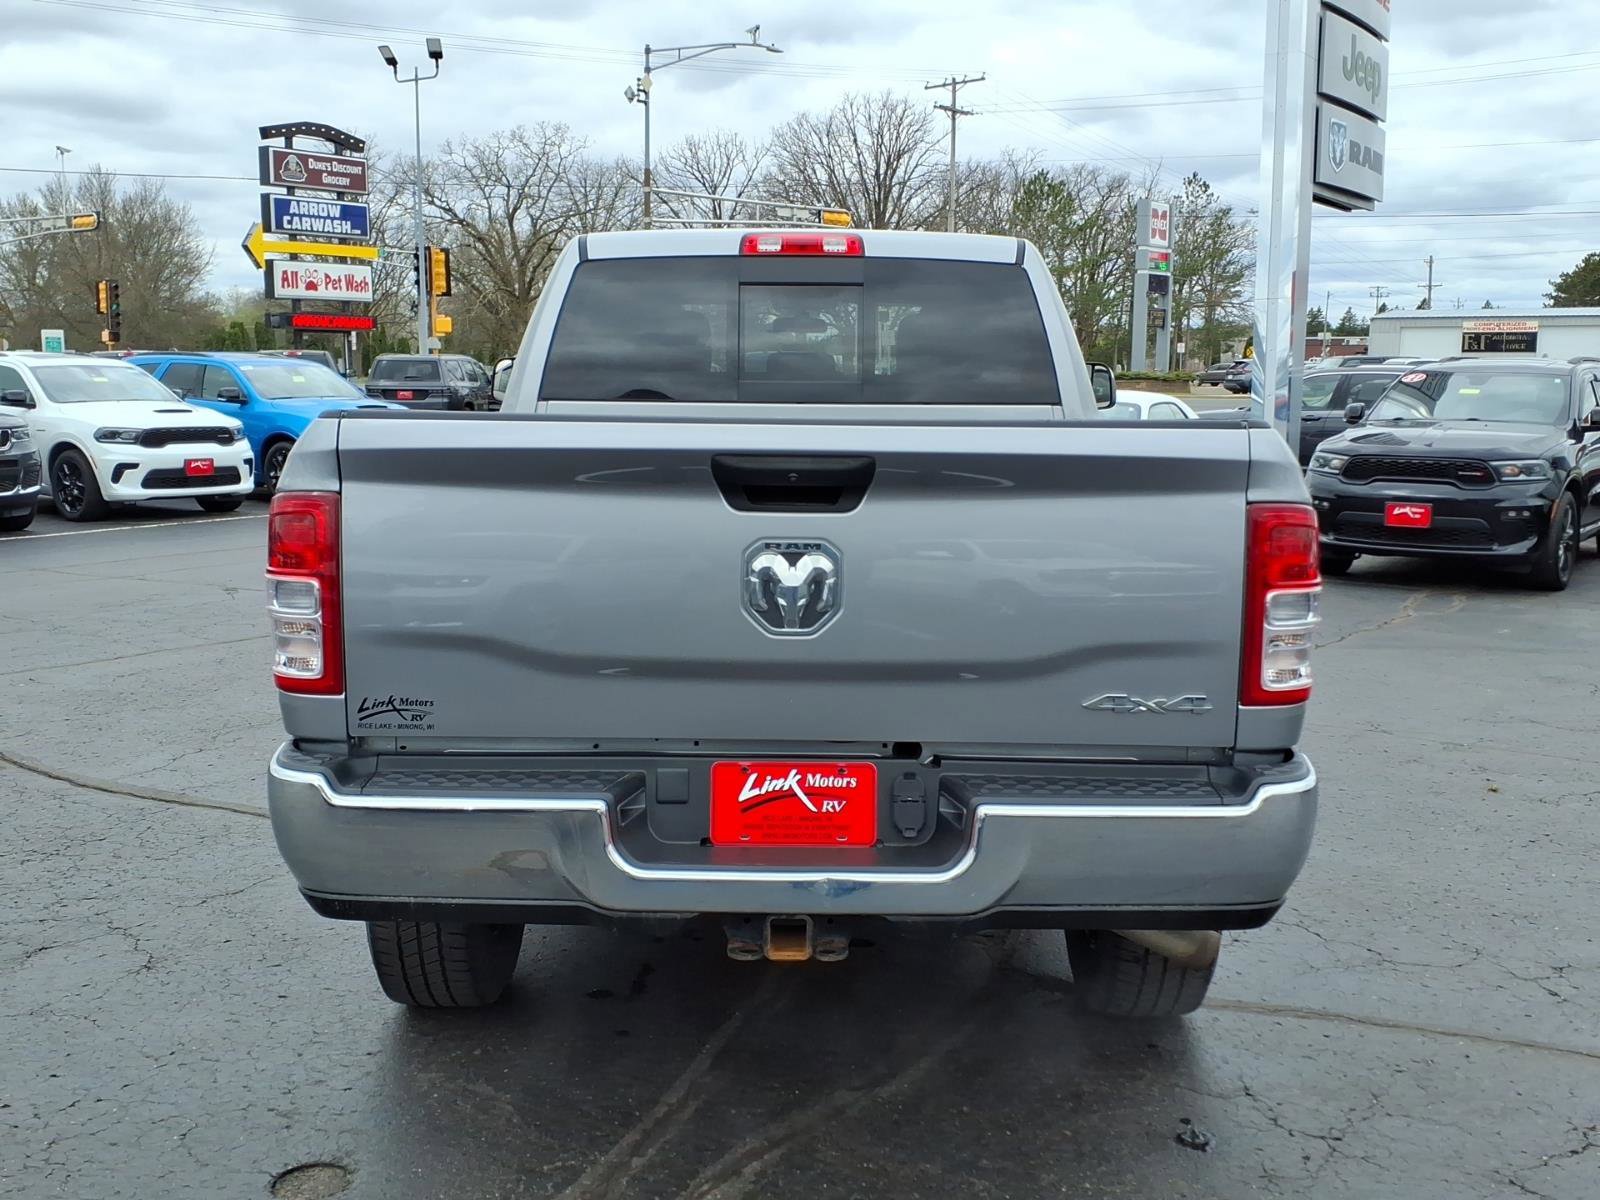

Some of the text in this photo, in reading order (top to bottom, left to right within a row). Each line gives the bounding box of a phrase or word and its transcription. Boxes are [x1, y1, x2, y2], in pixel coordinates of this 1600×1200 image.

[1342, 34, 1381, 105] Jeep
[1349, 139, 1383, 176] RAM
[308, 158, 363, 175] DUKE'S DISCOUNT
[322, 172, 350, 186] GROCERY
[289, 201, 341, 218] ARROW
[281, 270, 370, 293] All Pet Wash
[764, 543, 822, 551] RAM
[357, 694, 434, 721] Link Motors
[410, 713, 427, 722] RV
[374, 722, 393, 730] LAKE
[397, 723, 425, 731] MINONG,
[426, 723, 435, 731] WI
[737, 768, 858, 813] Link Motors
[821, 799, 847, 813] RV
